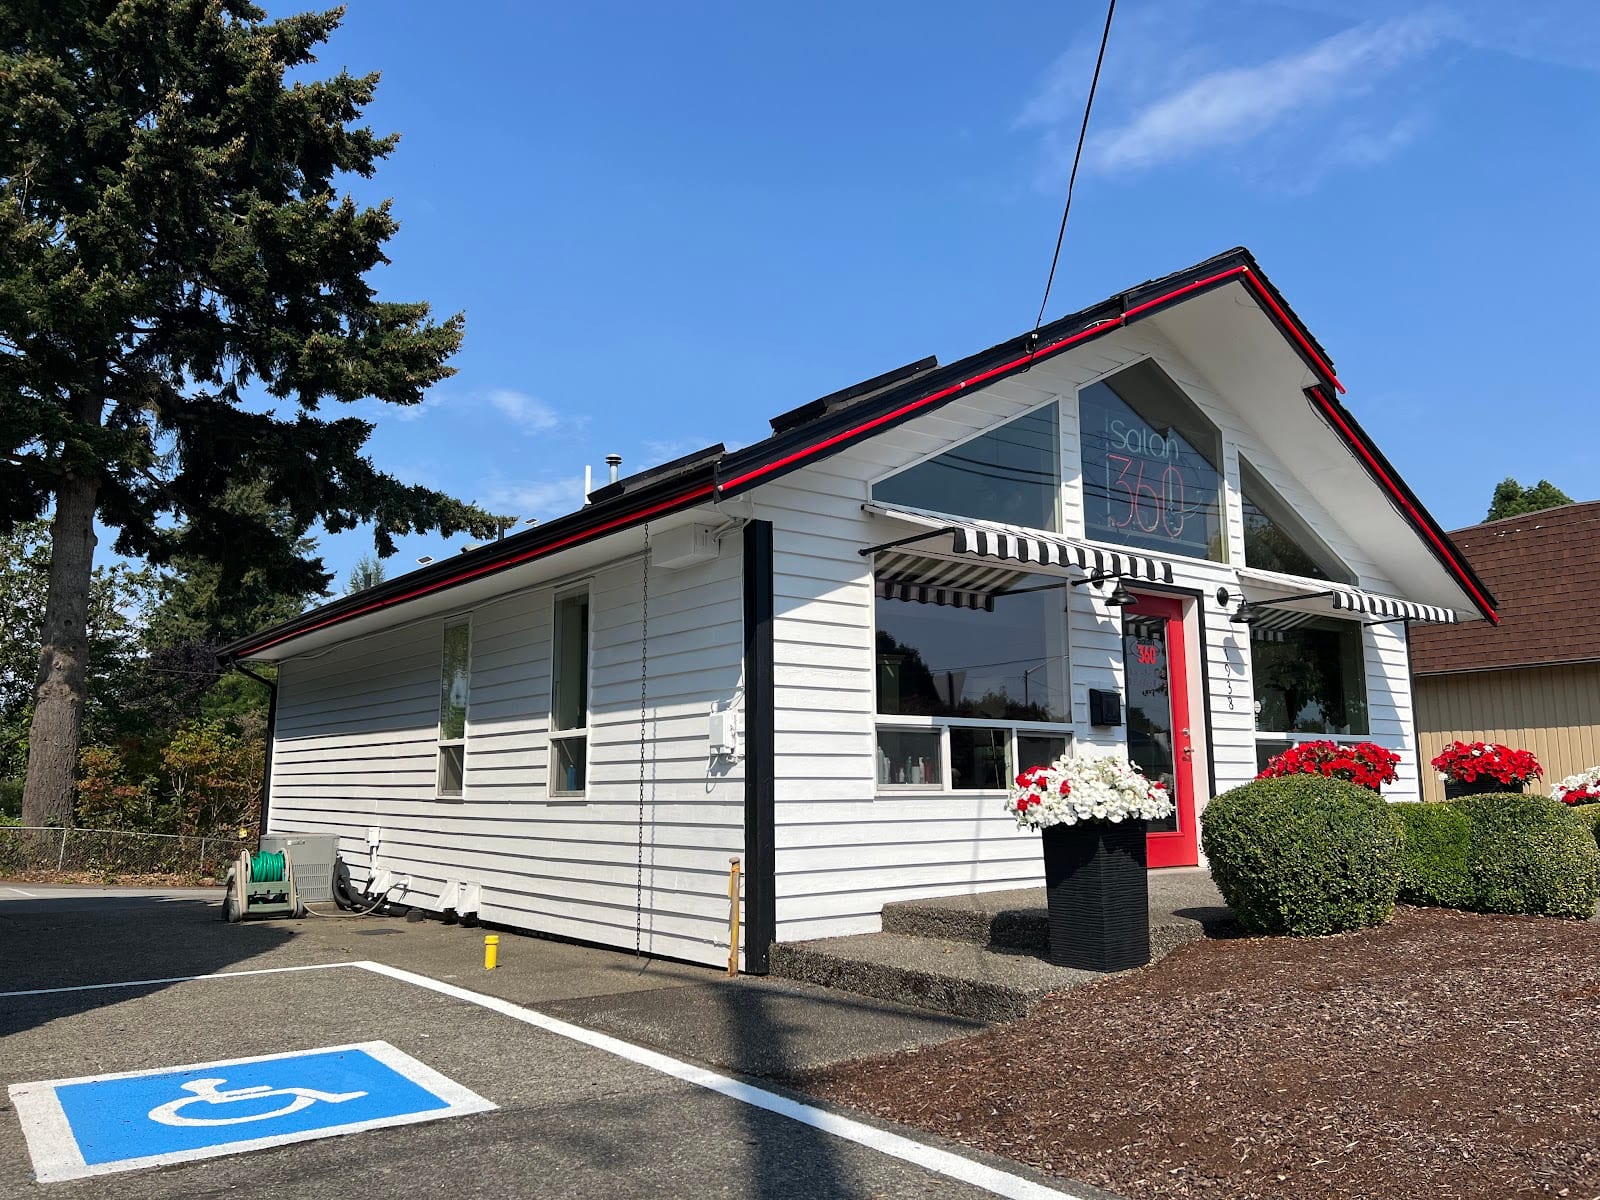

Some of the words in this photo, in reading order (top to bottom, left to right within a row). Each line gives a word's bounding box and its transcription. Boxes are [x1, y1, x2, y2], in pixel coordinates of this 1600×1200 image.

[1110, 419, 1179, 460] Salon
[1107, 453, 1184, 538] 360
[1137, 645, 1157, 665] 360
[1224, 647, 1234, 710] 1938
